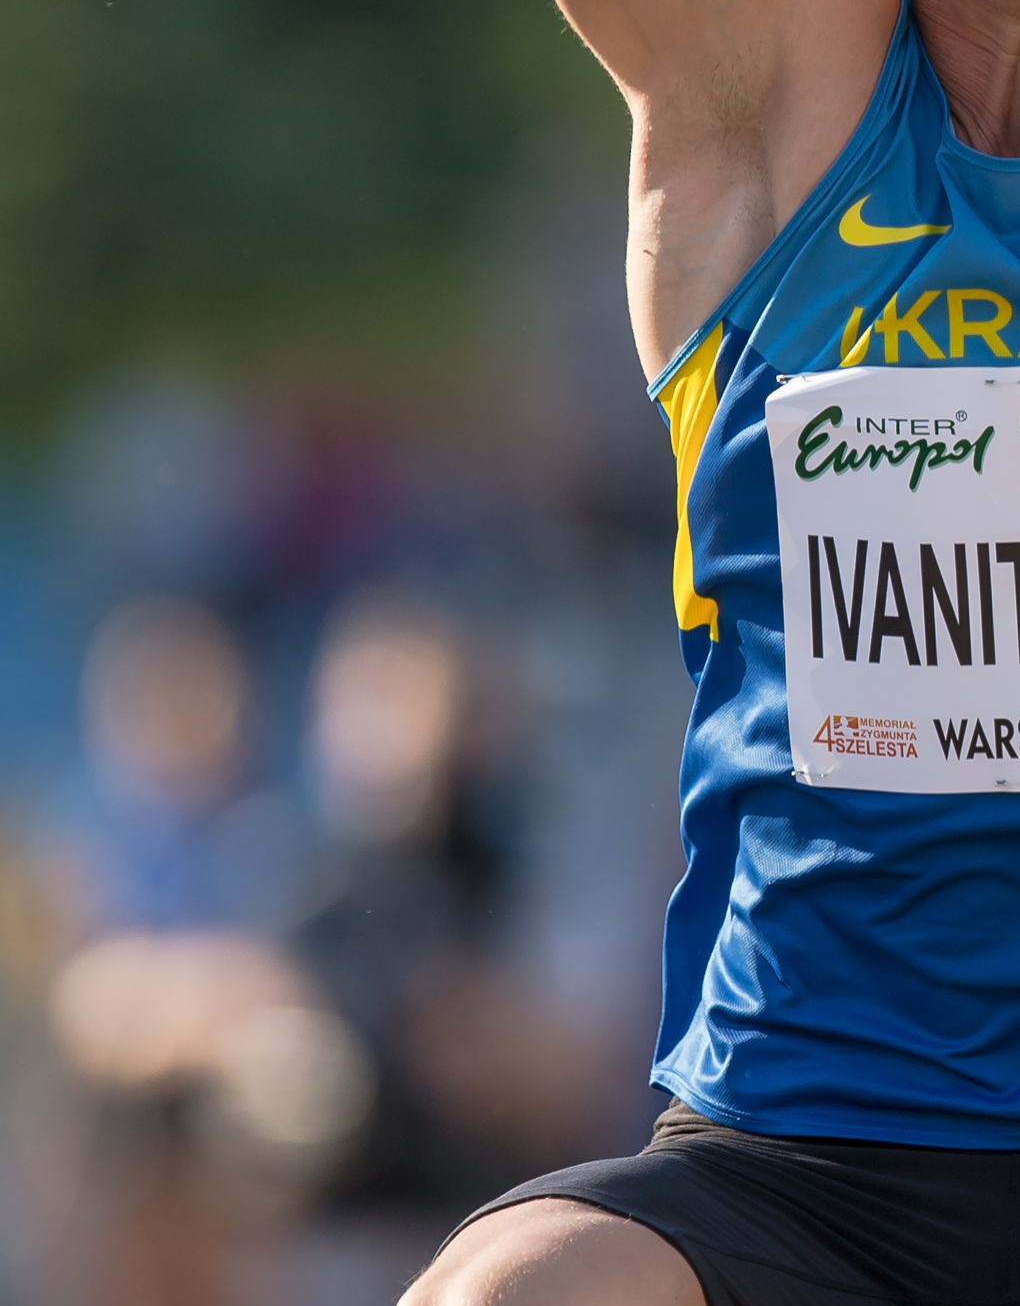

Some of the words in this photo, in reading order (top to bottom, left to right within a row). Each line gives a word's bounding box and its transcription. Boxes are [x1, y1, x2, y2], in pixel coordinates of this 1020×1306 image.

[795, 405, 995, 492] Europol
[860, 717, 917, 730] MEMORIAŁ
[860, 729, 918, 742] ZYGMUNTA
[835, 738, 919, 759] SZELESTA
